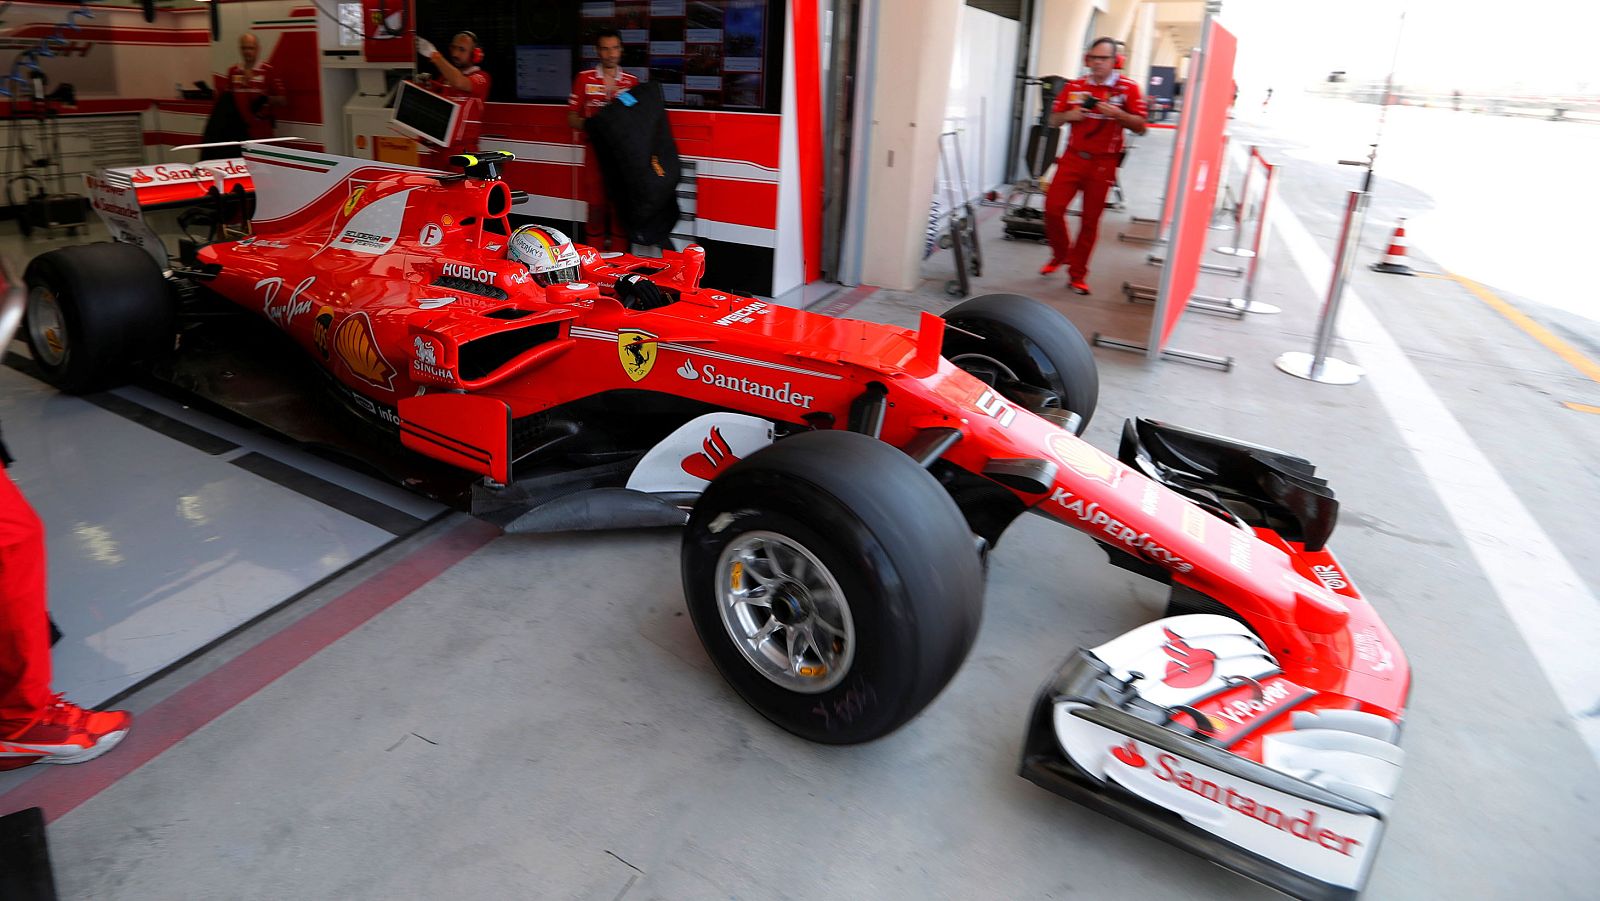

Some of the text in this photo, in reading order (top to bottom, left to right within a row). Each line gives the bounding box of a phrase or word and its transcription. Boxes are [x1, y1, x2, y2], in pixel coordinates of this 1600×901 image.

[154, 160, 248, 182] Santade
[344, 230, 381, 241] SCUDERIA
[422, 225, 437, 245] E
[442, 262, 498, 285] HUBLOT
[413, 359, 454, 380] SINGHA
[701, 364, 815, 409] Santander
[976, 389, 1017, 428] 5
[1049, 486, 1185, 564] KASPERSKY
[1216, 680, 1291, 725] V-Power
[1152, 752, 1363, 858] Santander
